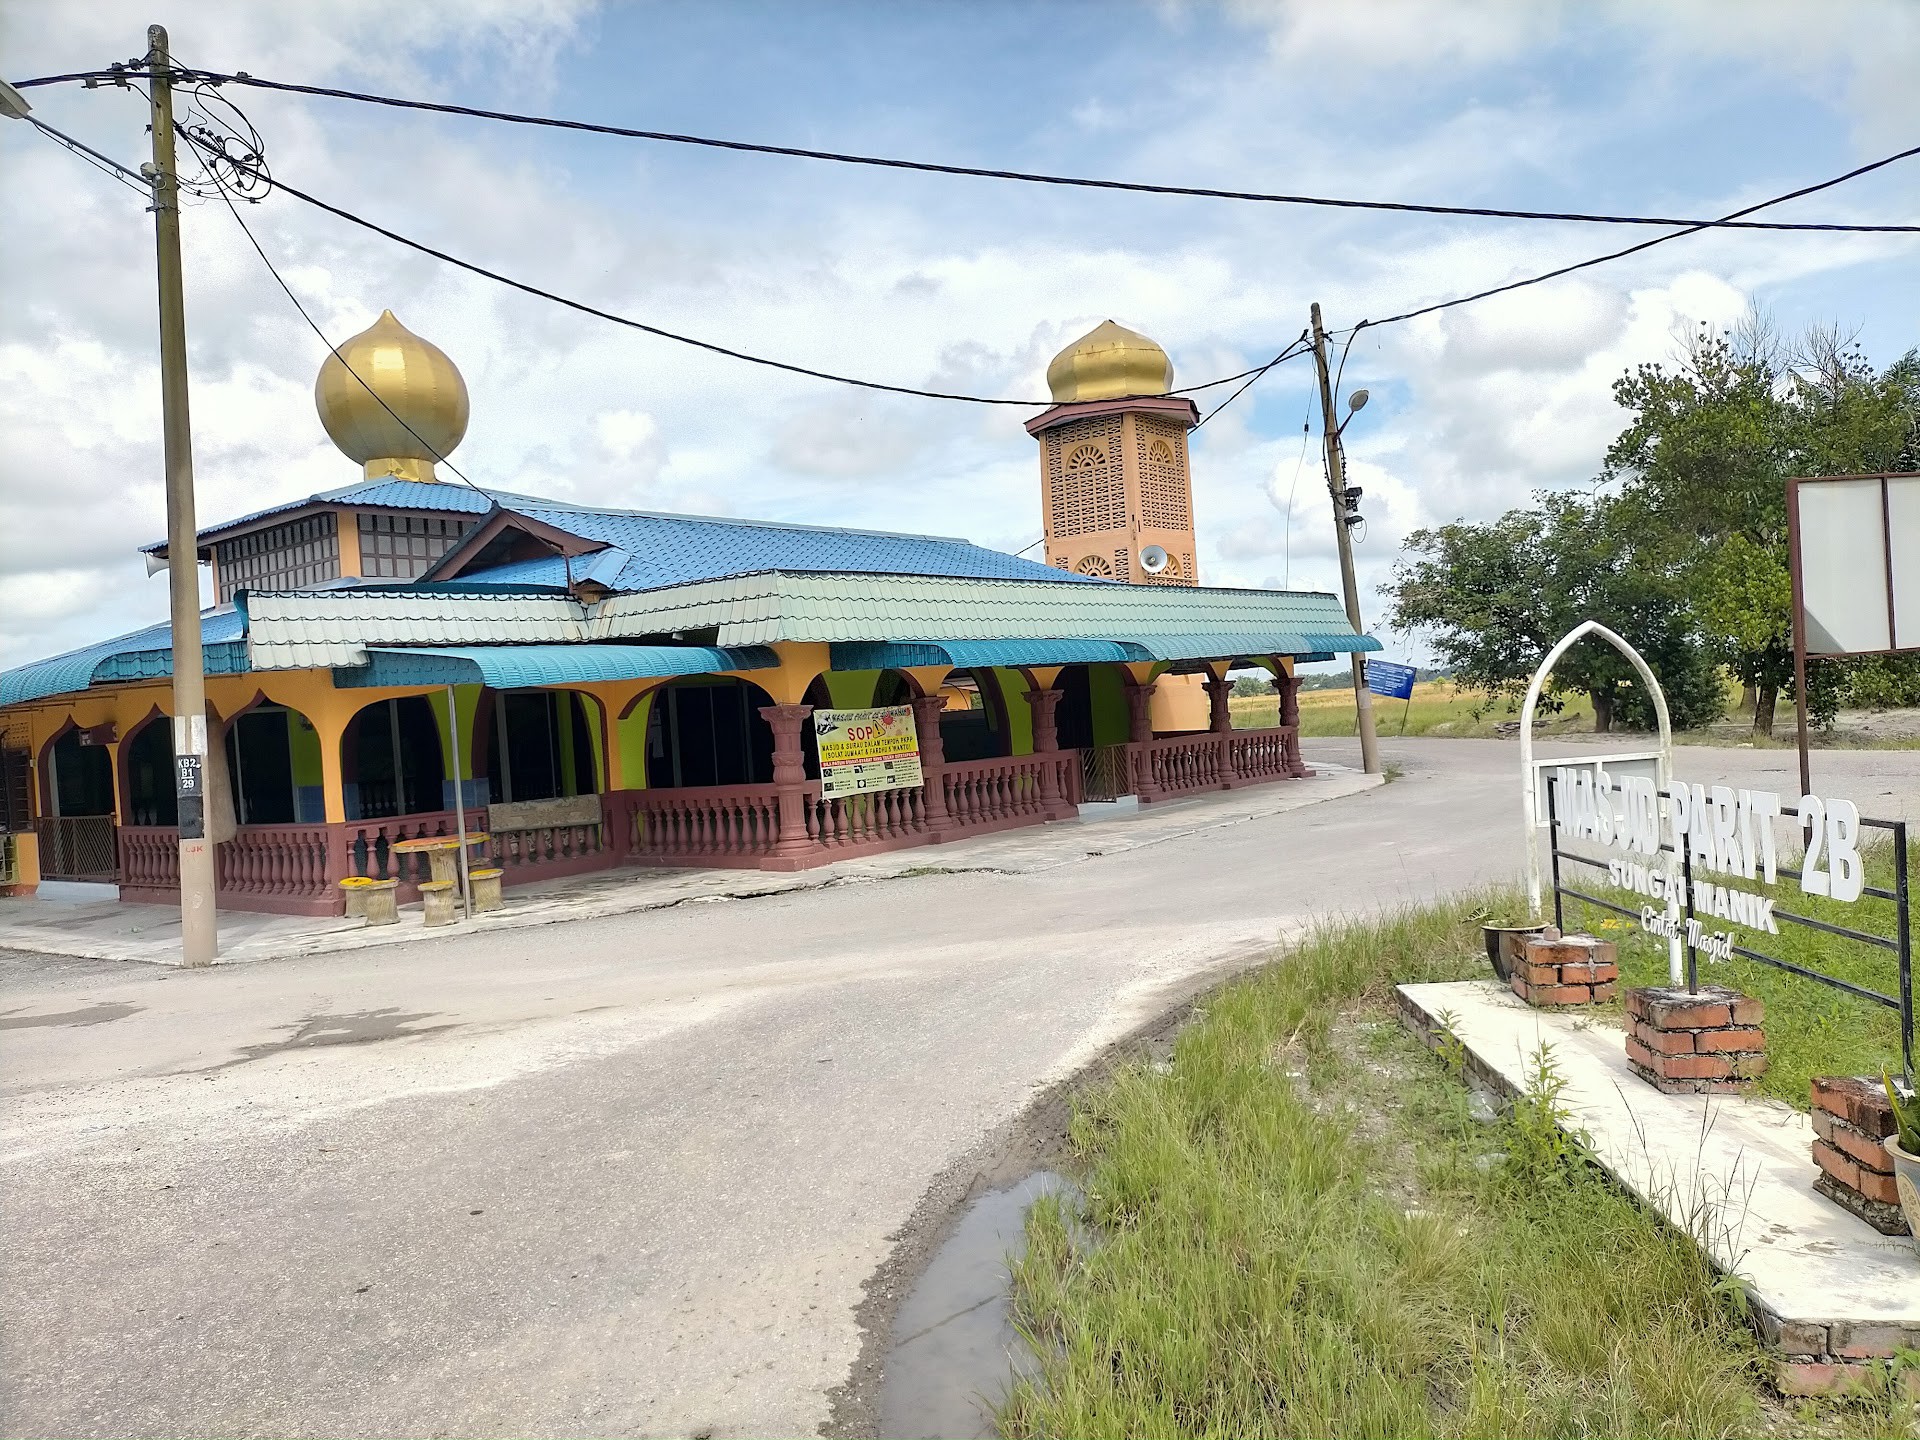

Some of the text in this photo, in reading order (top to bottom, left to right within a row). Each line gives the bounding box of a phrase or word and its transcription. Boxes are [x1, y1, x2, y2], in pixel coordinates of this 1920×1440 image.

[847, 726, 873, 742] SOP
[846, 741, 863, 749] SURAU
[864, 739, 880, 748] DALAM
[881, 738, 899, 747] TEMPOH
[844, 749, 863, 757] JUMAAT
[870, 746, 888, 755] FARDHU
[181, 768, 193, 777] B1
[182, 779, 195, 789] 29
[1555, 767, 1865, 902] MASJID PARIT 2B
[1608, 858, 1780, 935] SUNGAI MANIK
[1686, 917, 1735, 965] Masjid
